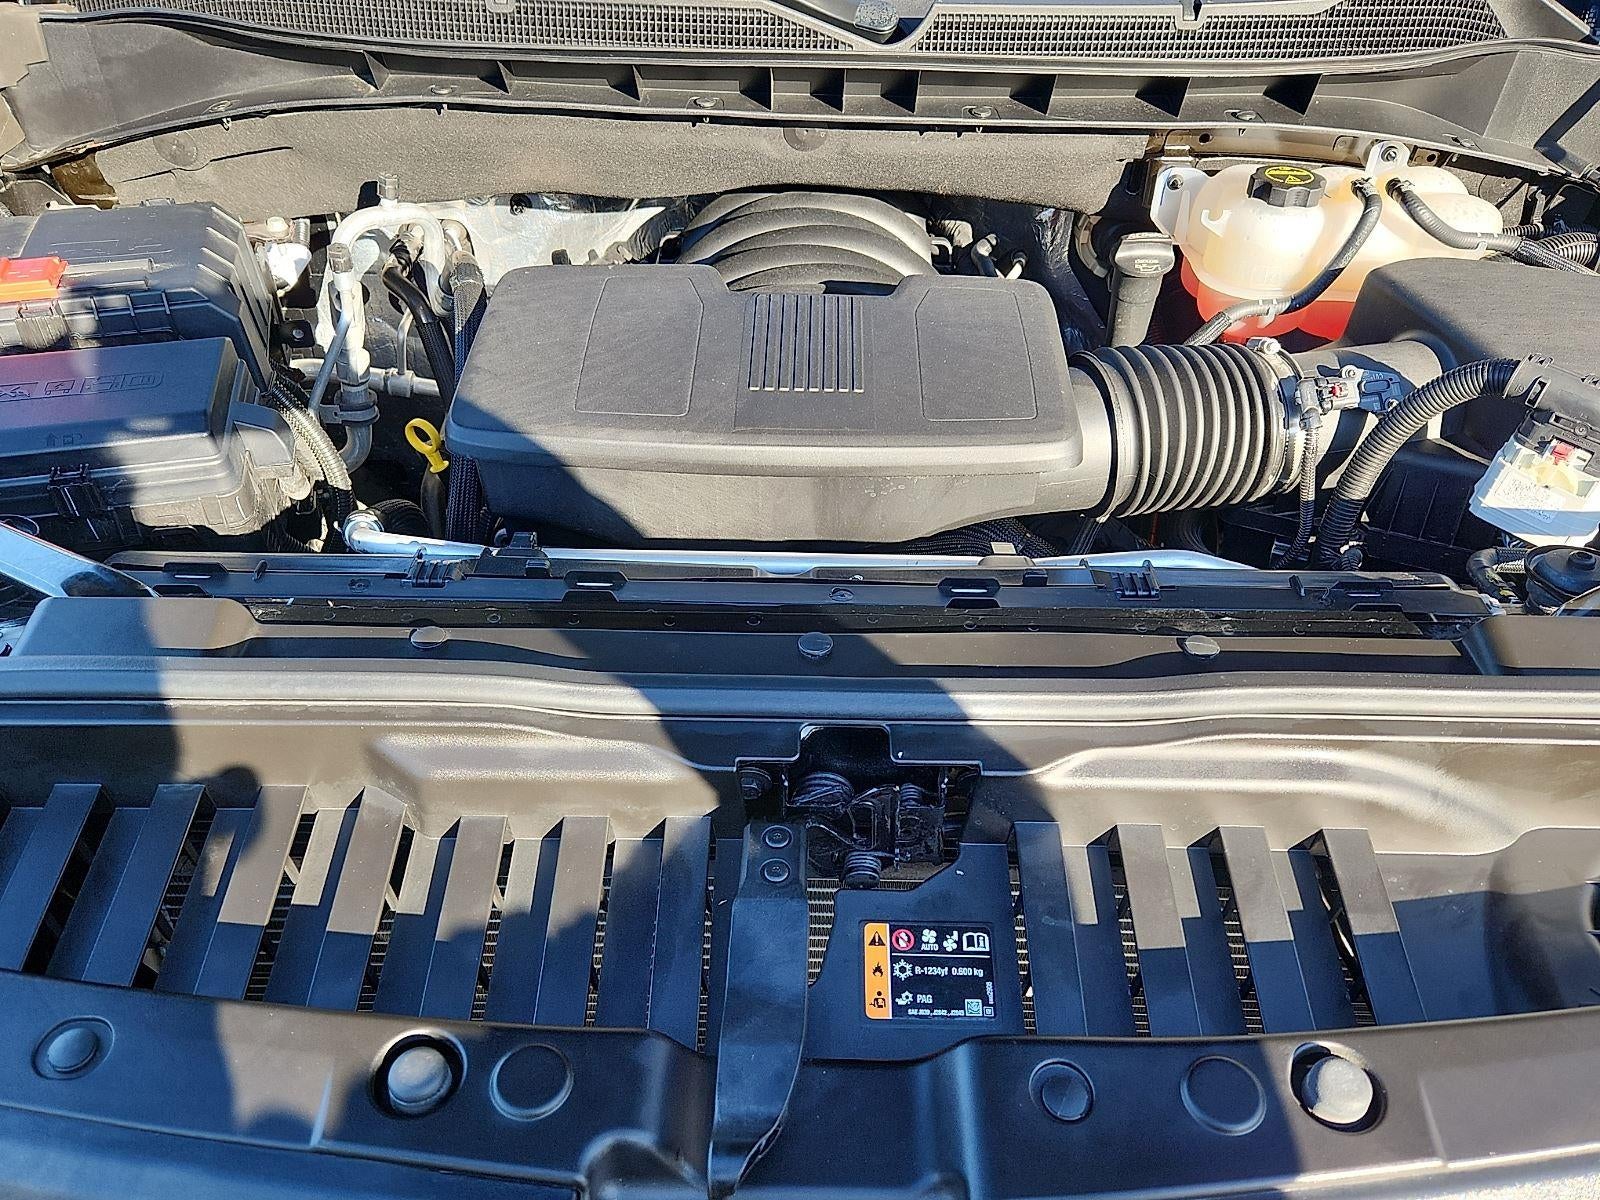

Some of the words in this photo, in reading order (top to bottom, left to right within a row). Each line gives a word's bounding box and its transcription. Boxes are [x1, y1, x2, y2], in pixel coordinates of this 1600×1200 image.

[915, 966, 948, 977] R-1234yf
[973, 968, 984, 977] kg
[916, 995, 933, 1004] PAG
